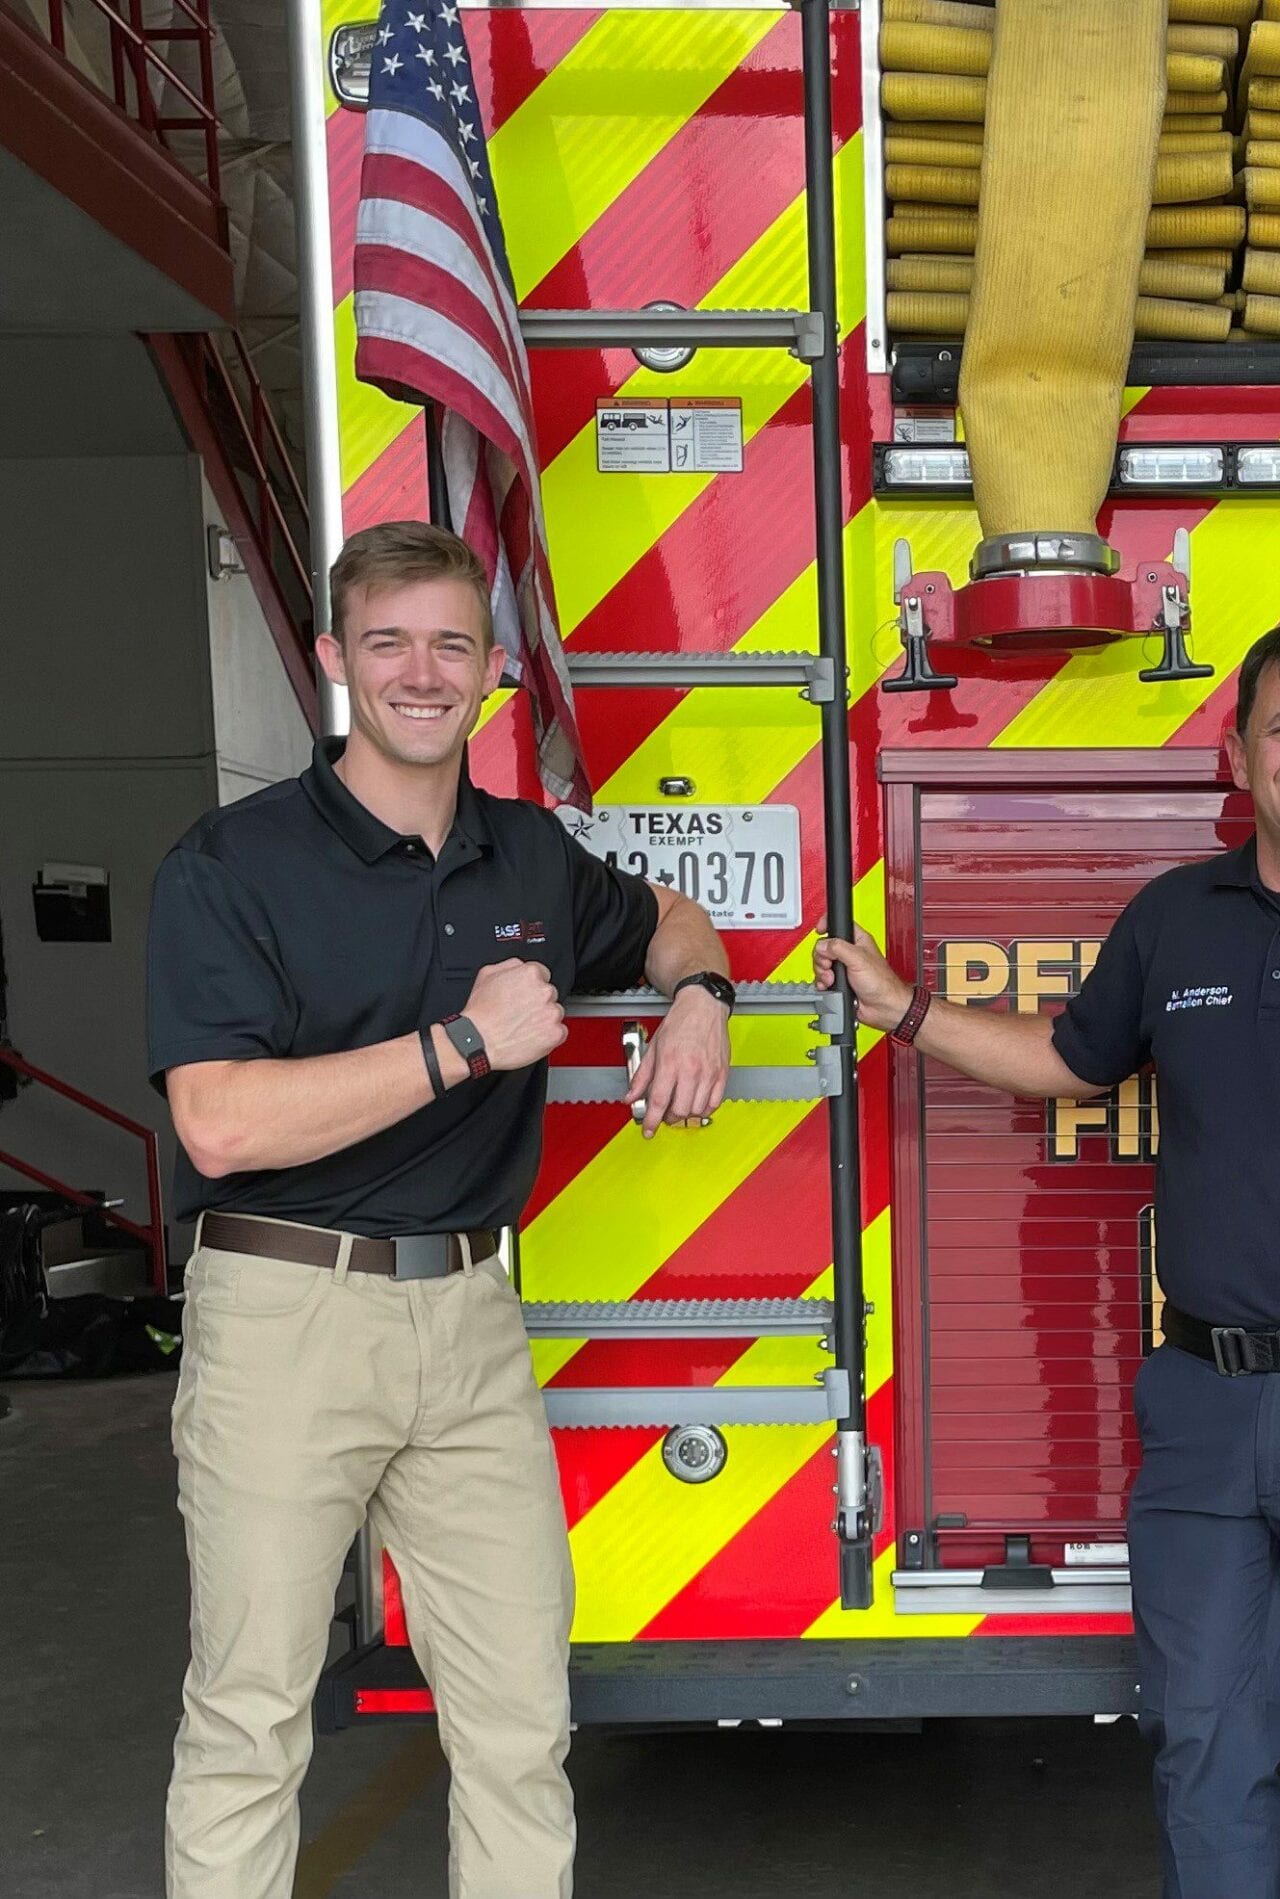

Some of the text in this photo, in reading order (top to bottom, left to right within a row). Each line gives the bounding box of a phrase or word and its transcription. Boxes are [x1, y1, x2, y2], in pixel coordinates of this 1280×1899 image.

[629, 812, 723, 835] TEXAS
[649, 836, 704, 847] EXEMPT
[1183, 986, 1229, 998] Anderson
[1205, 995, 1233, 1006] Chief
